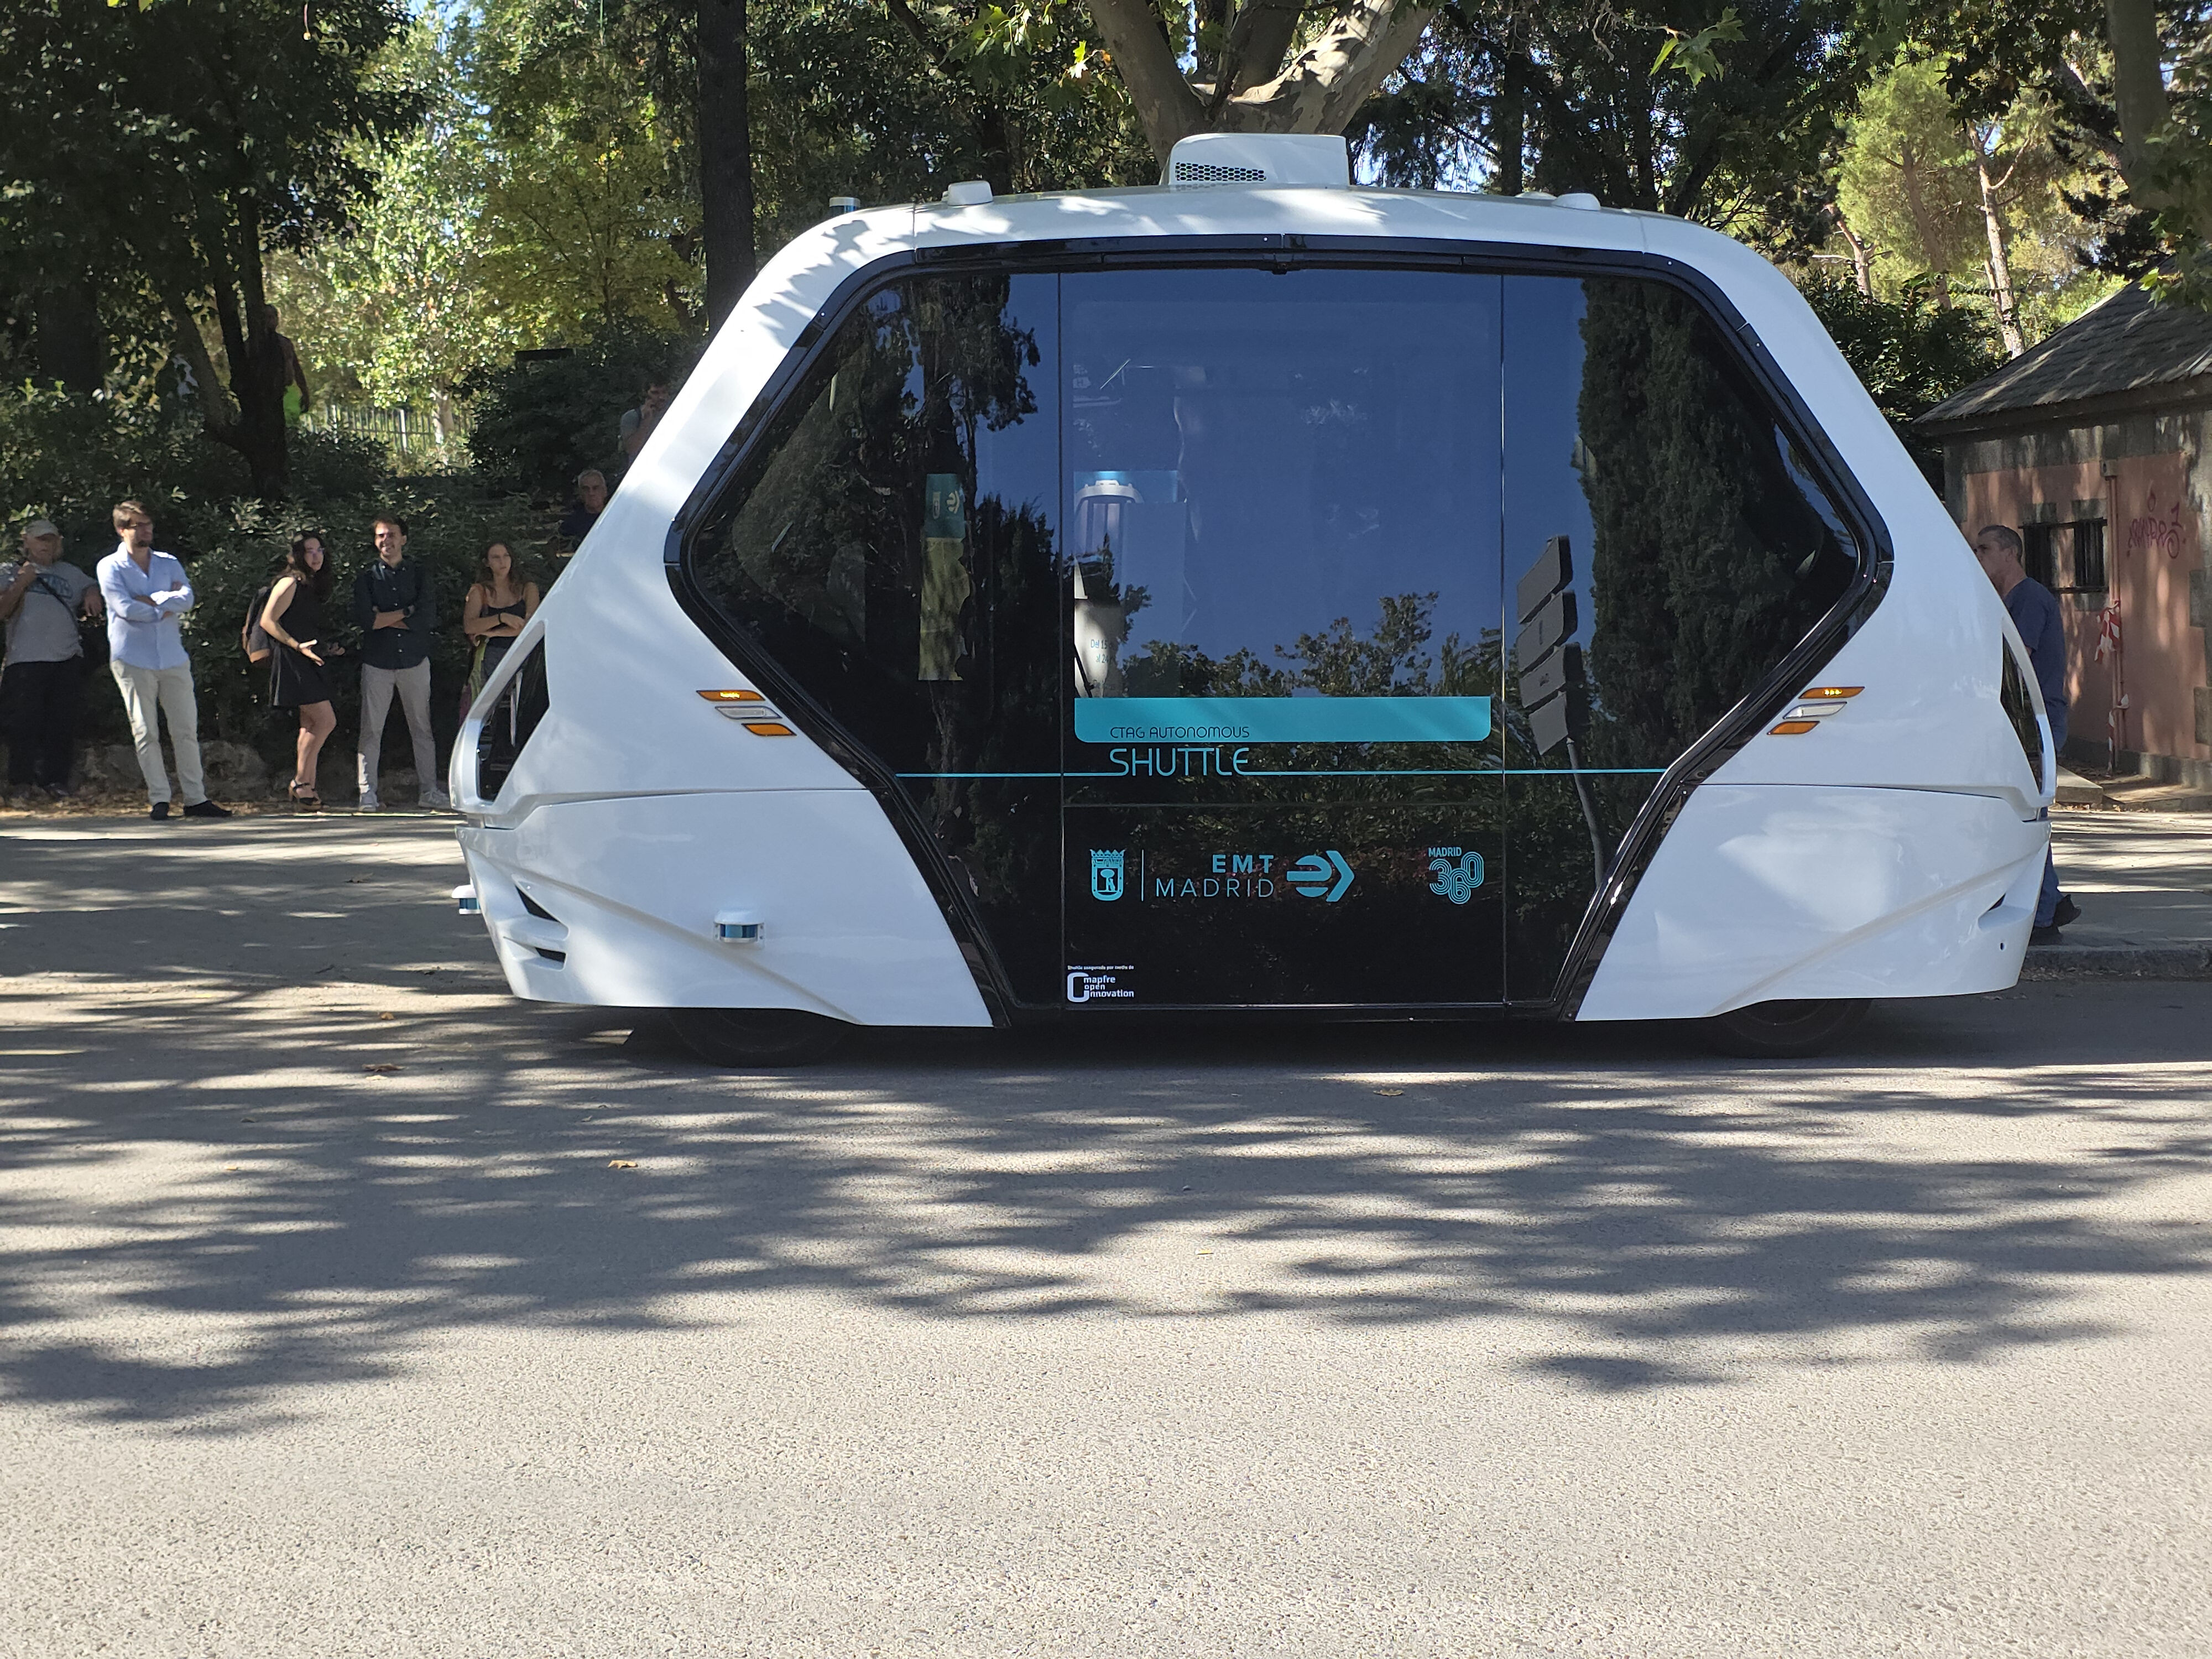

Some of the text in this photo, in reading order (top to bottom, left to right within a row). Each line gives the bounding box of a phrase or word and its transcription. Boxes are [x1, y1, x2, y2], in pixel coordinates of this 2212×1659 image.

[1110, 726, 1250, 739] CTAG AUTONOMOUS
[1109, 747, 1250, 776] SHUTTLE
[1428, 847, 1462, 857] MADRID
[1212, 854, 1274, 874] EMT
[1156, 878, 1274, 898] MADRID
[1429, 851, 1484, 905] 360
[1084, 975, 1116, 985] mapfre
